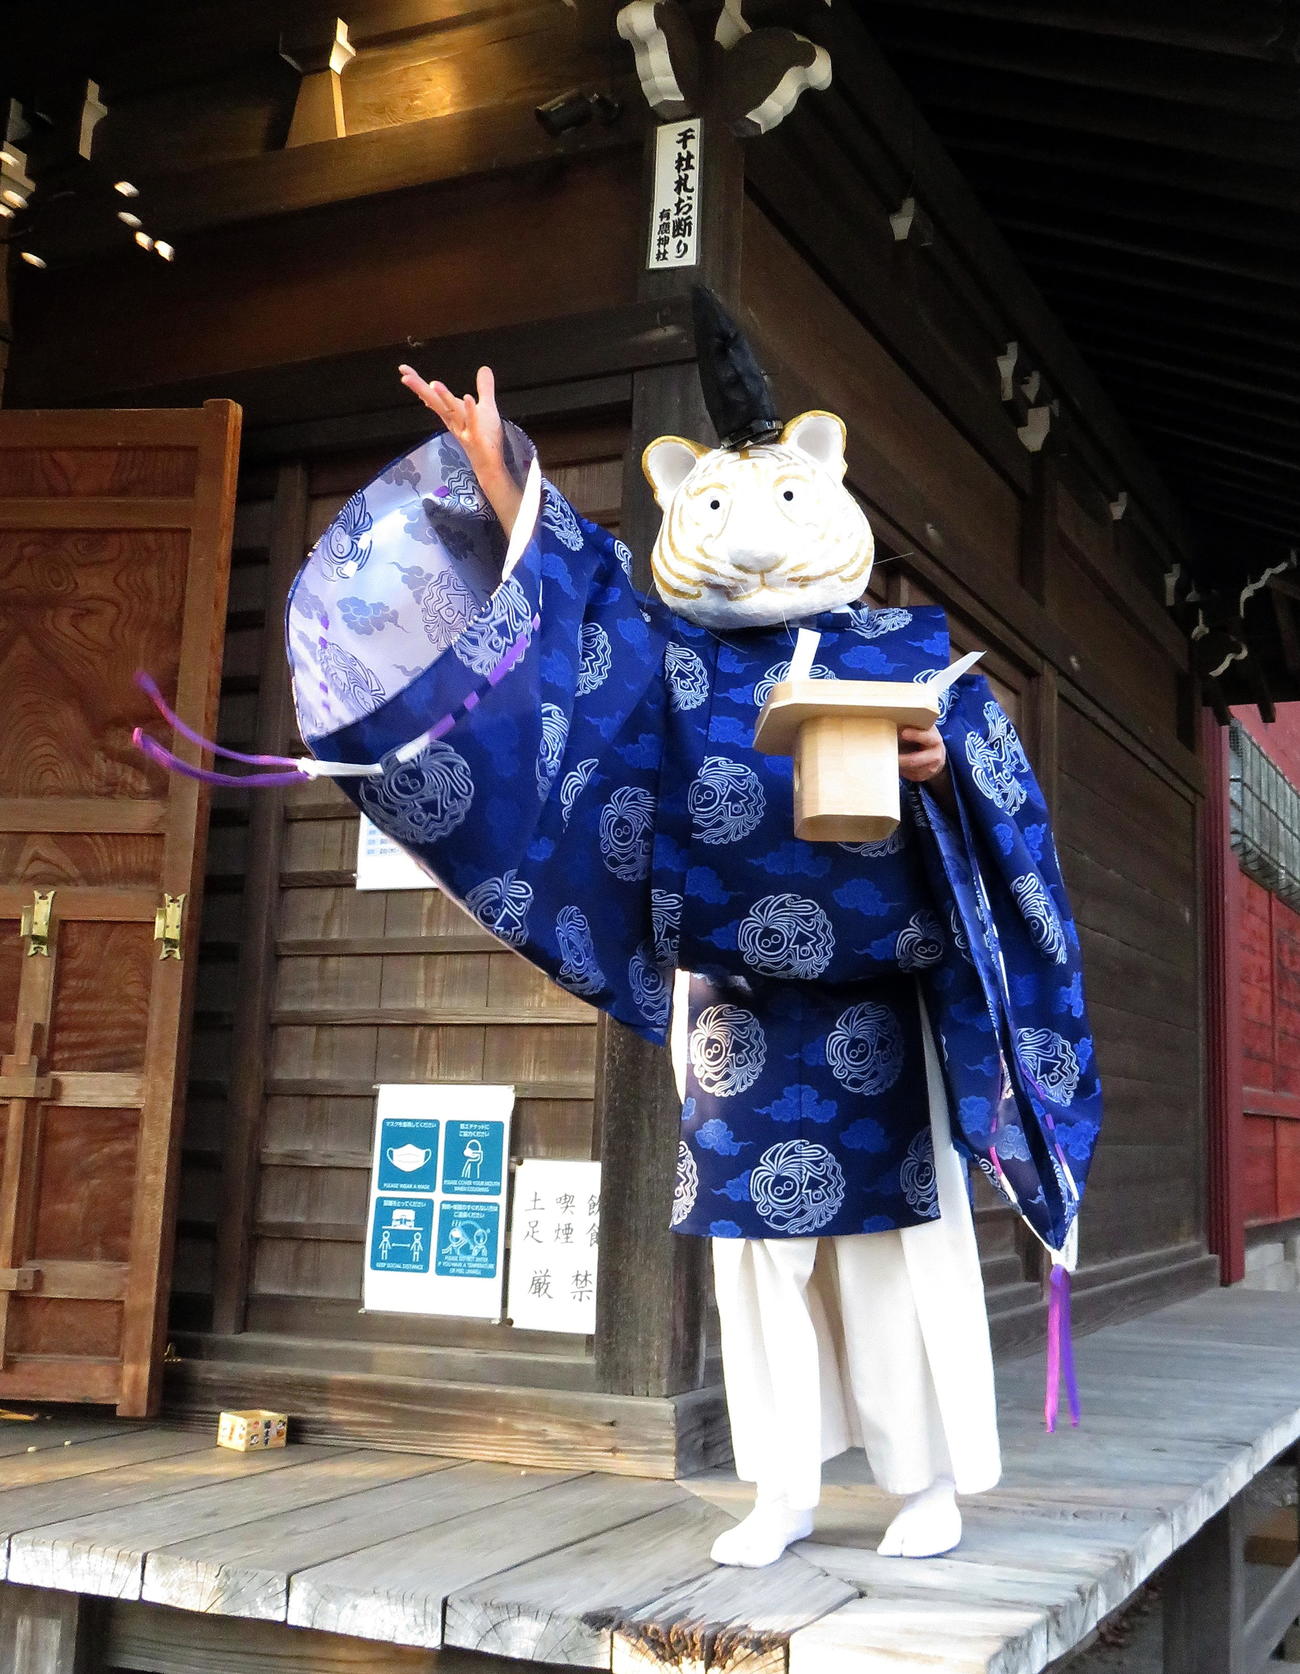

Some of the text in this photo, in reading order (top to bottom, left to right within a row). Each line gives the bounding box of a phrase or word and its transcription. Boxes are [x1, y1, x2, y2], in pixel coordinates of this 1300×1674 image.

[672, 127, 696, 259] 千社札お断り
[655, 208, 672, 262] 有鹿神社
[523, 1191, 545, 1244] 土足
[554, 1192, 576, 1244] 喫煙
[528, 1268, 593, 1303] 厳禁
